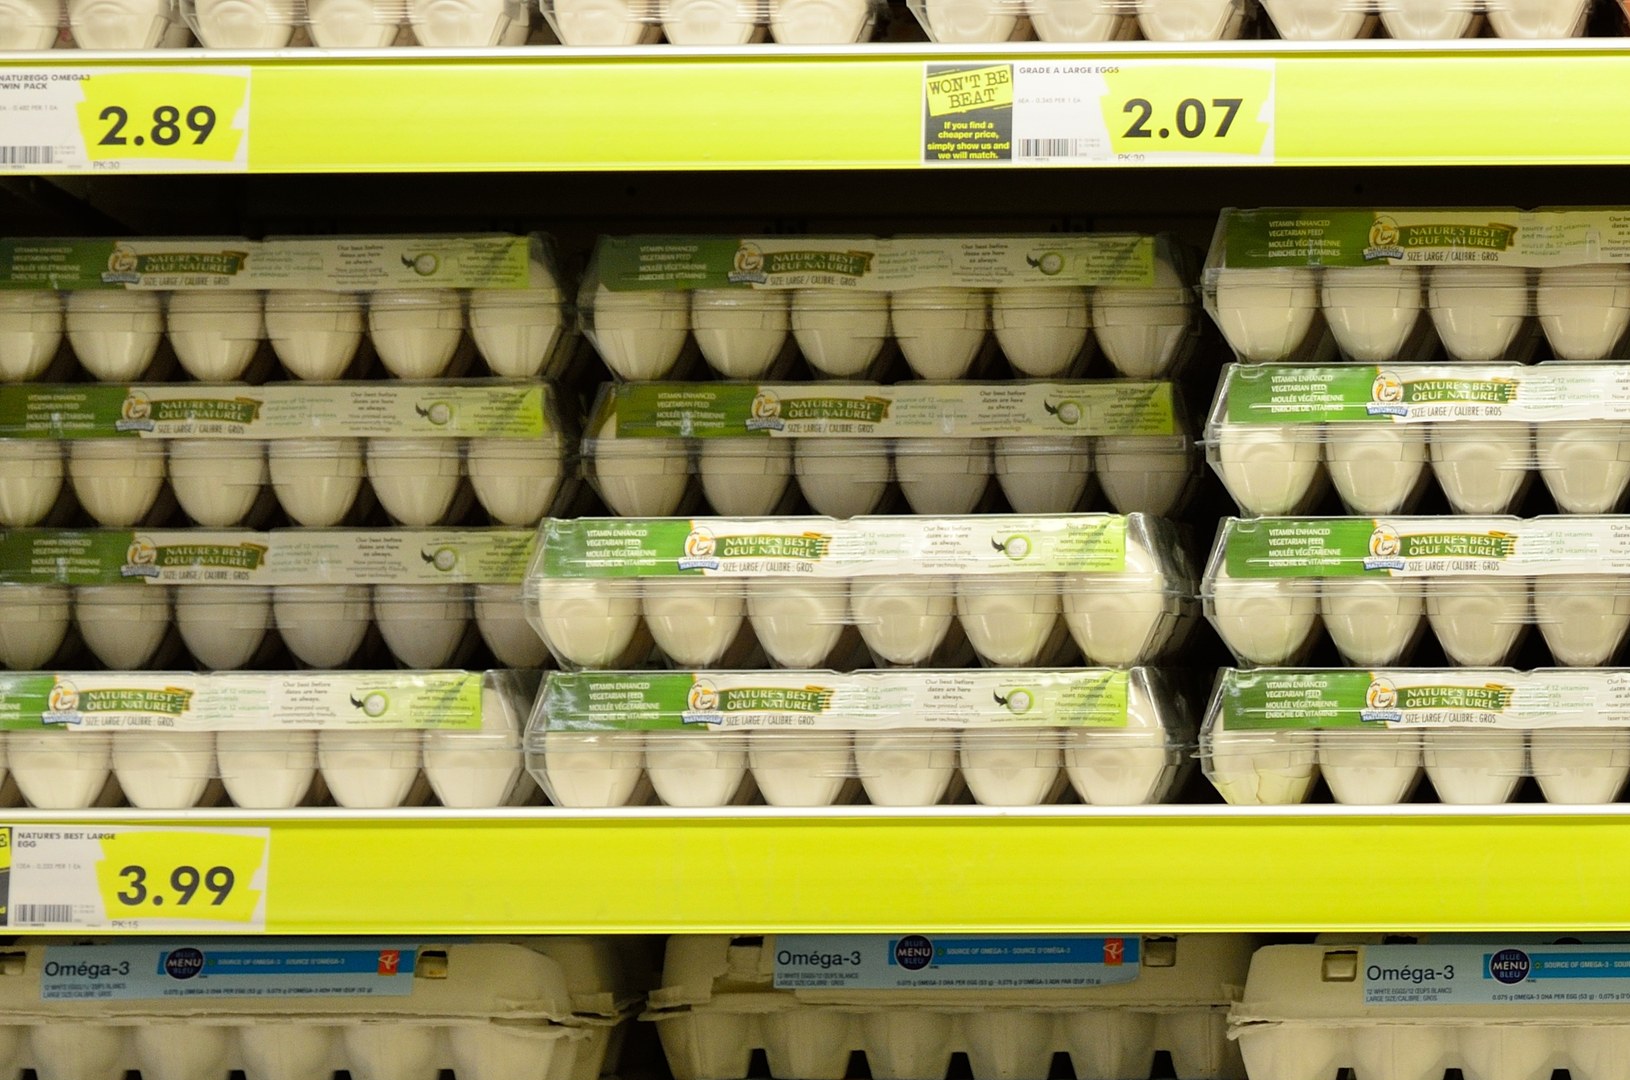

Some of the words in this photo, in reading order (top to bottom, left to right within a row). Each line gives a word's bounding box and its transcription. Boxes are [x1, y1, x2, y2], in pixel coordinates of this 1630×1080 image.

[929, 73, 981, 95] WON'T
[987, 70, 1009, 84] BE
[949, 88, 996, 109] BEAT
[97, 105, 216, 146] 2.89
[1122, 98, 1243, 139] 2.07
[1408, 688, 1463, 698] NATURE'S
[1466, 689, 1495, 698] BEST
[1406, 698, 1439, 708] OEUF
[1442, 698, 1493, 708] NATUREL
[1422, 714, 1441, 723] LARGE
[1449, 714, 1473, 723] CALIBRE
[1480, 714, 1496, 723] GROS
[18, 840, 36, 848] EGG
[117, 865, 235, 906] 3.99
[776, 951, 861, 968] Oméga-3
[44, 961, 130, 979] Oméga-3
[1366, 965, 1454, 984] Oméga-3
